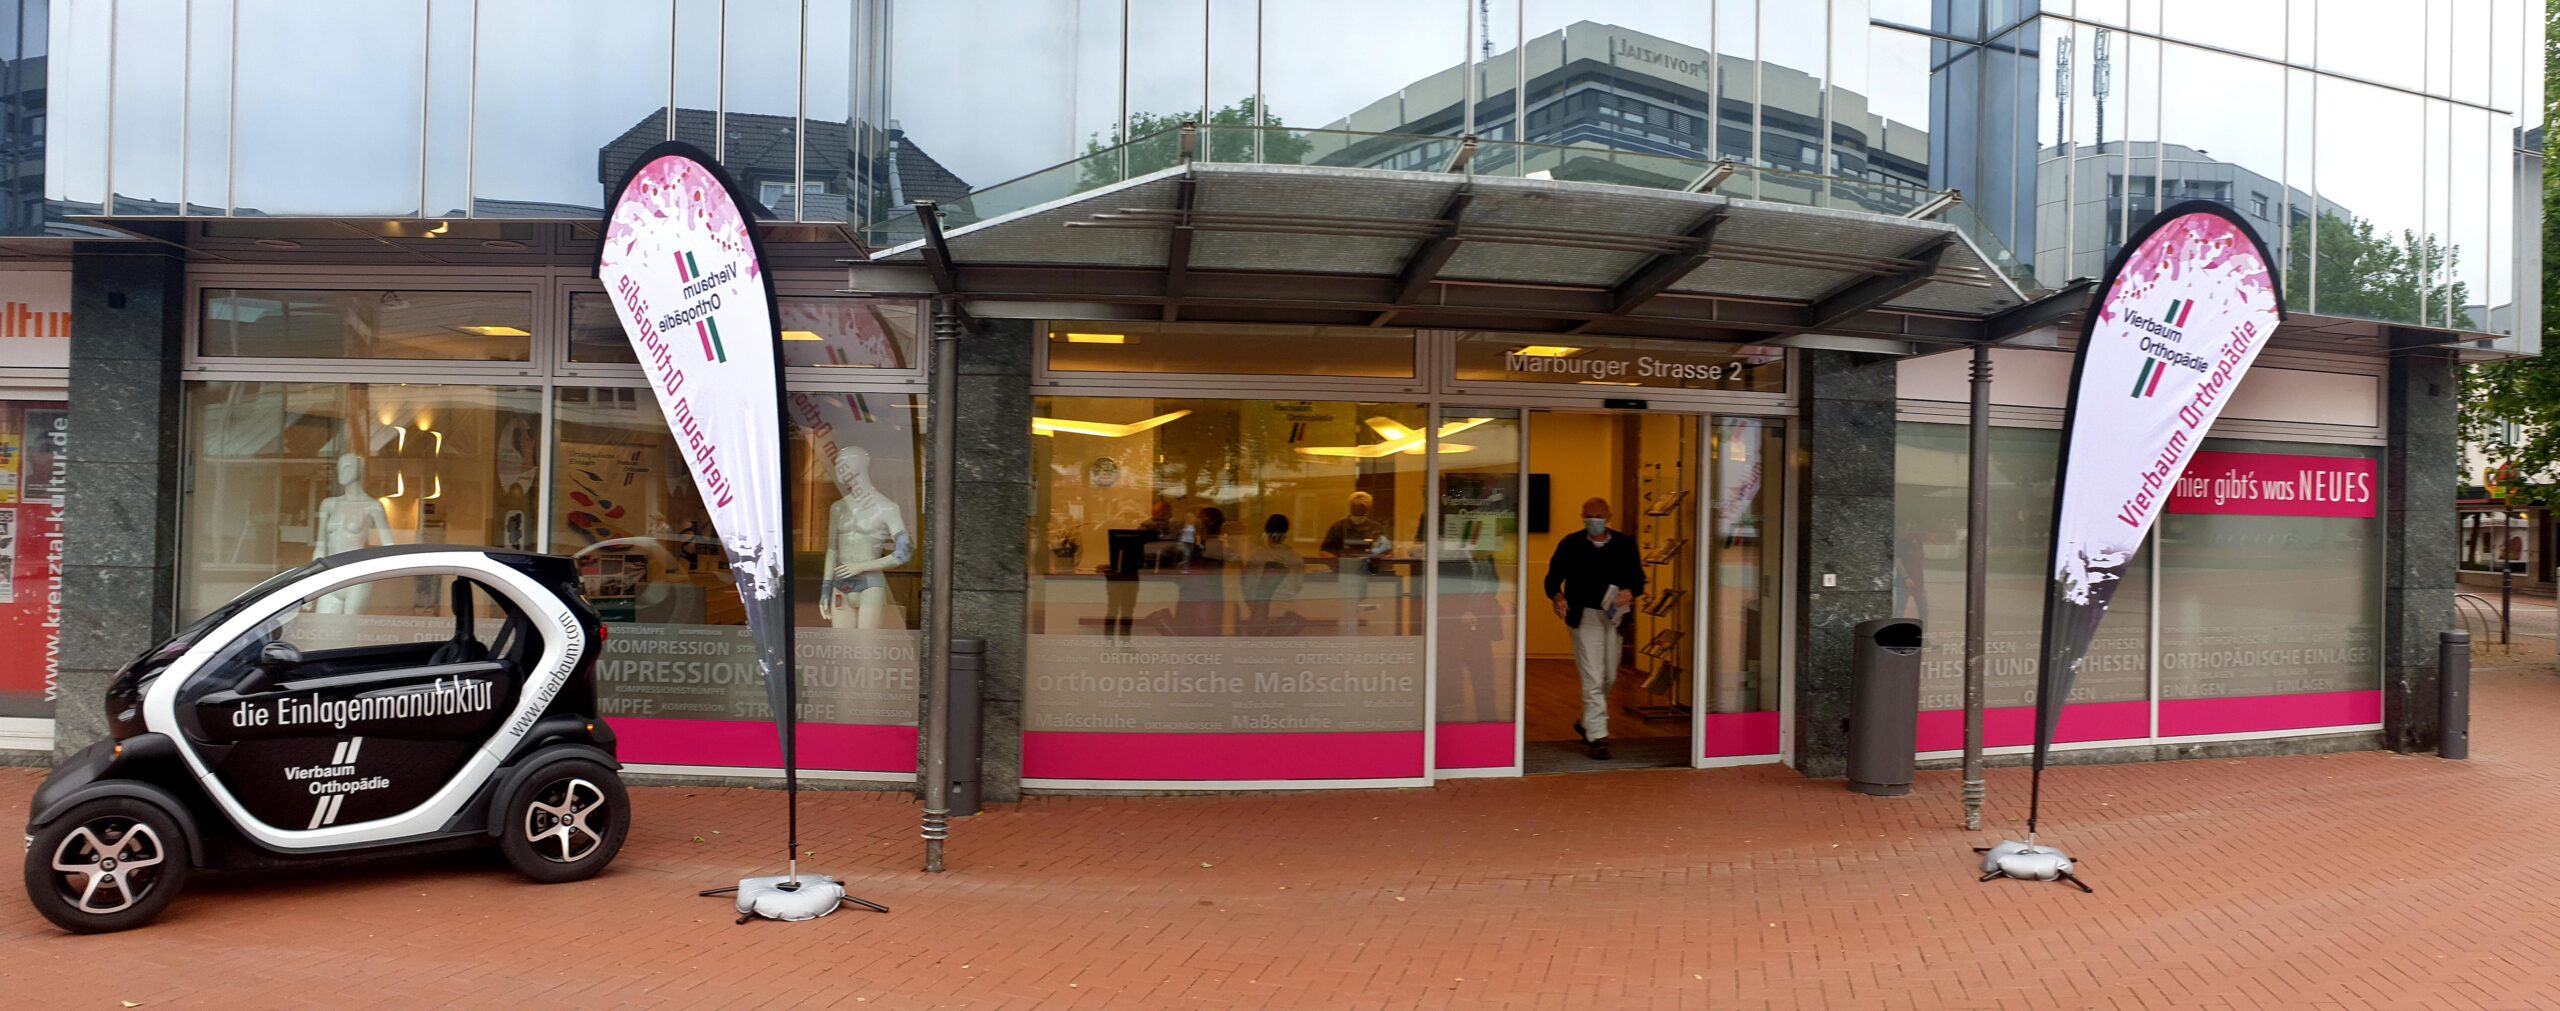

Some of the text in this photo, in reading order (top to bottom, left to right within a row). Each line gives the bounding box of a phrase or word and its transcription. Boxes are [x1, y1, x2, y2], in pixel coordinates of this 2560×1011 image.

[0, 301, 72, 338] ltur
[2123, 307, 2182, 343] Vierbaum
[1504, 350, 1743, 381] Marburger Strasse 2
[2139, 336, 2209, 373] Orthopädie
[2117, 319, 2258, 529] Vierbaum Orthopädie
[2262, 480, 2295, 501] was
[2299, 469, 2371, 503] NEUES
[41, 416, 69, 702] www.kreuztal-kultur.de
[606, 639, 729, 656] KOMPRESSION
[2162, 646, 2300, 670] ORTHOPÄDISCHE
[509, 611, 581, 738] www.vierbaum.com
[1995, 657, 2038, 676] UND
[1036, 669, 1414, 698] orthopädische Maßschuhe
[232, 674, 494, 730] die Einlagenmanufaktur
[1034, 712, 1137, 729] Maßschuhe
[1231, 713, 1333, 729] Maßschuhe
[284, 763, 356, 781] Vierbaum
[308, 776, 390, 796] Orthopädie
